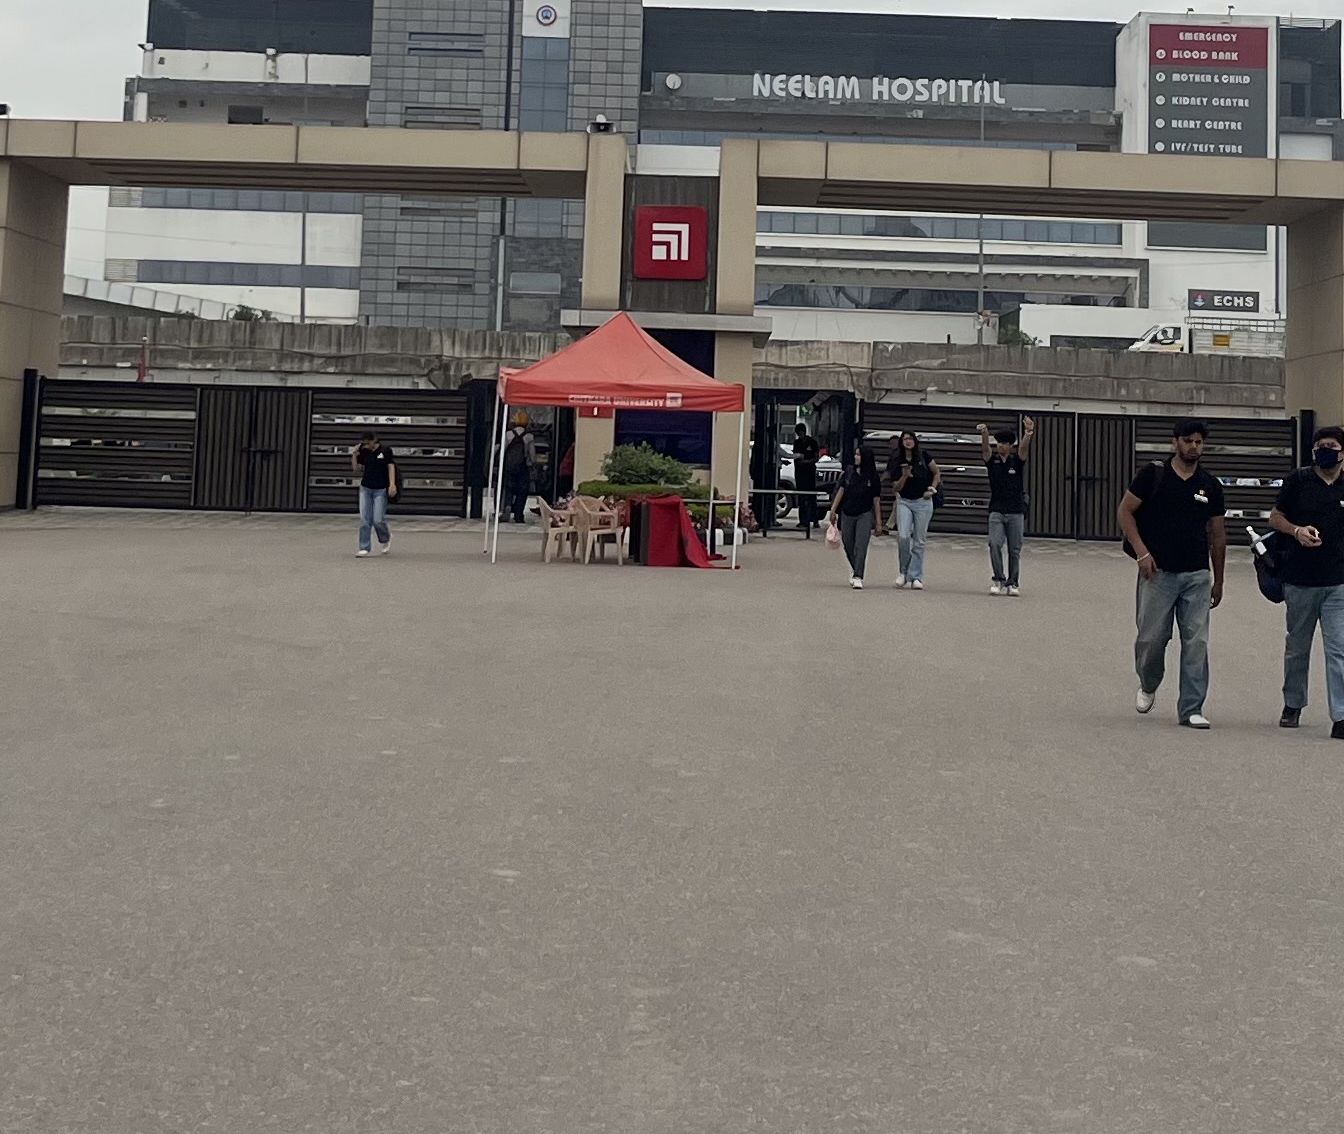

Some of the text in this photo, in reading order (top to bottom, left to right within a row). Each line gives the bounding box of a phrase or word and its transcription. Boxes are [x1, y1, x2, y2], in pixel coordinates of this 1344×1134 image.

[1179, 32, 1238, 42] EMERGENCY
[1172, 50, 1239, 61] BLOOD BANK
[1172, 72, 1212, 83] MOTHER
[1221, 74, 1251, 84] CHILD
[752, 73, 1006, 105] NEELAM HOSPITAL
[1171, 96, 1250, 108] KIDNEY CENTRE
[1171, 119, 1242, 131] HEART CENTRE
[1218, 144, 1243, 154] TUBE
[1213, 295, 1255, 308] ECHS
